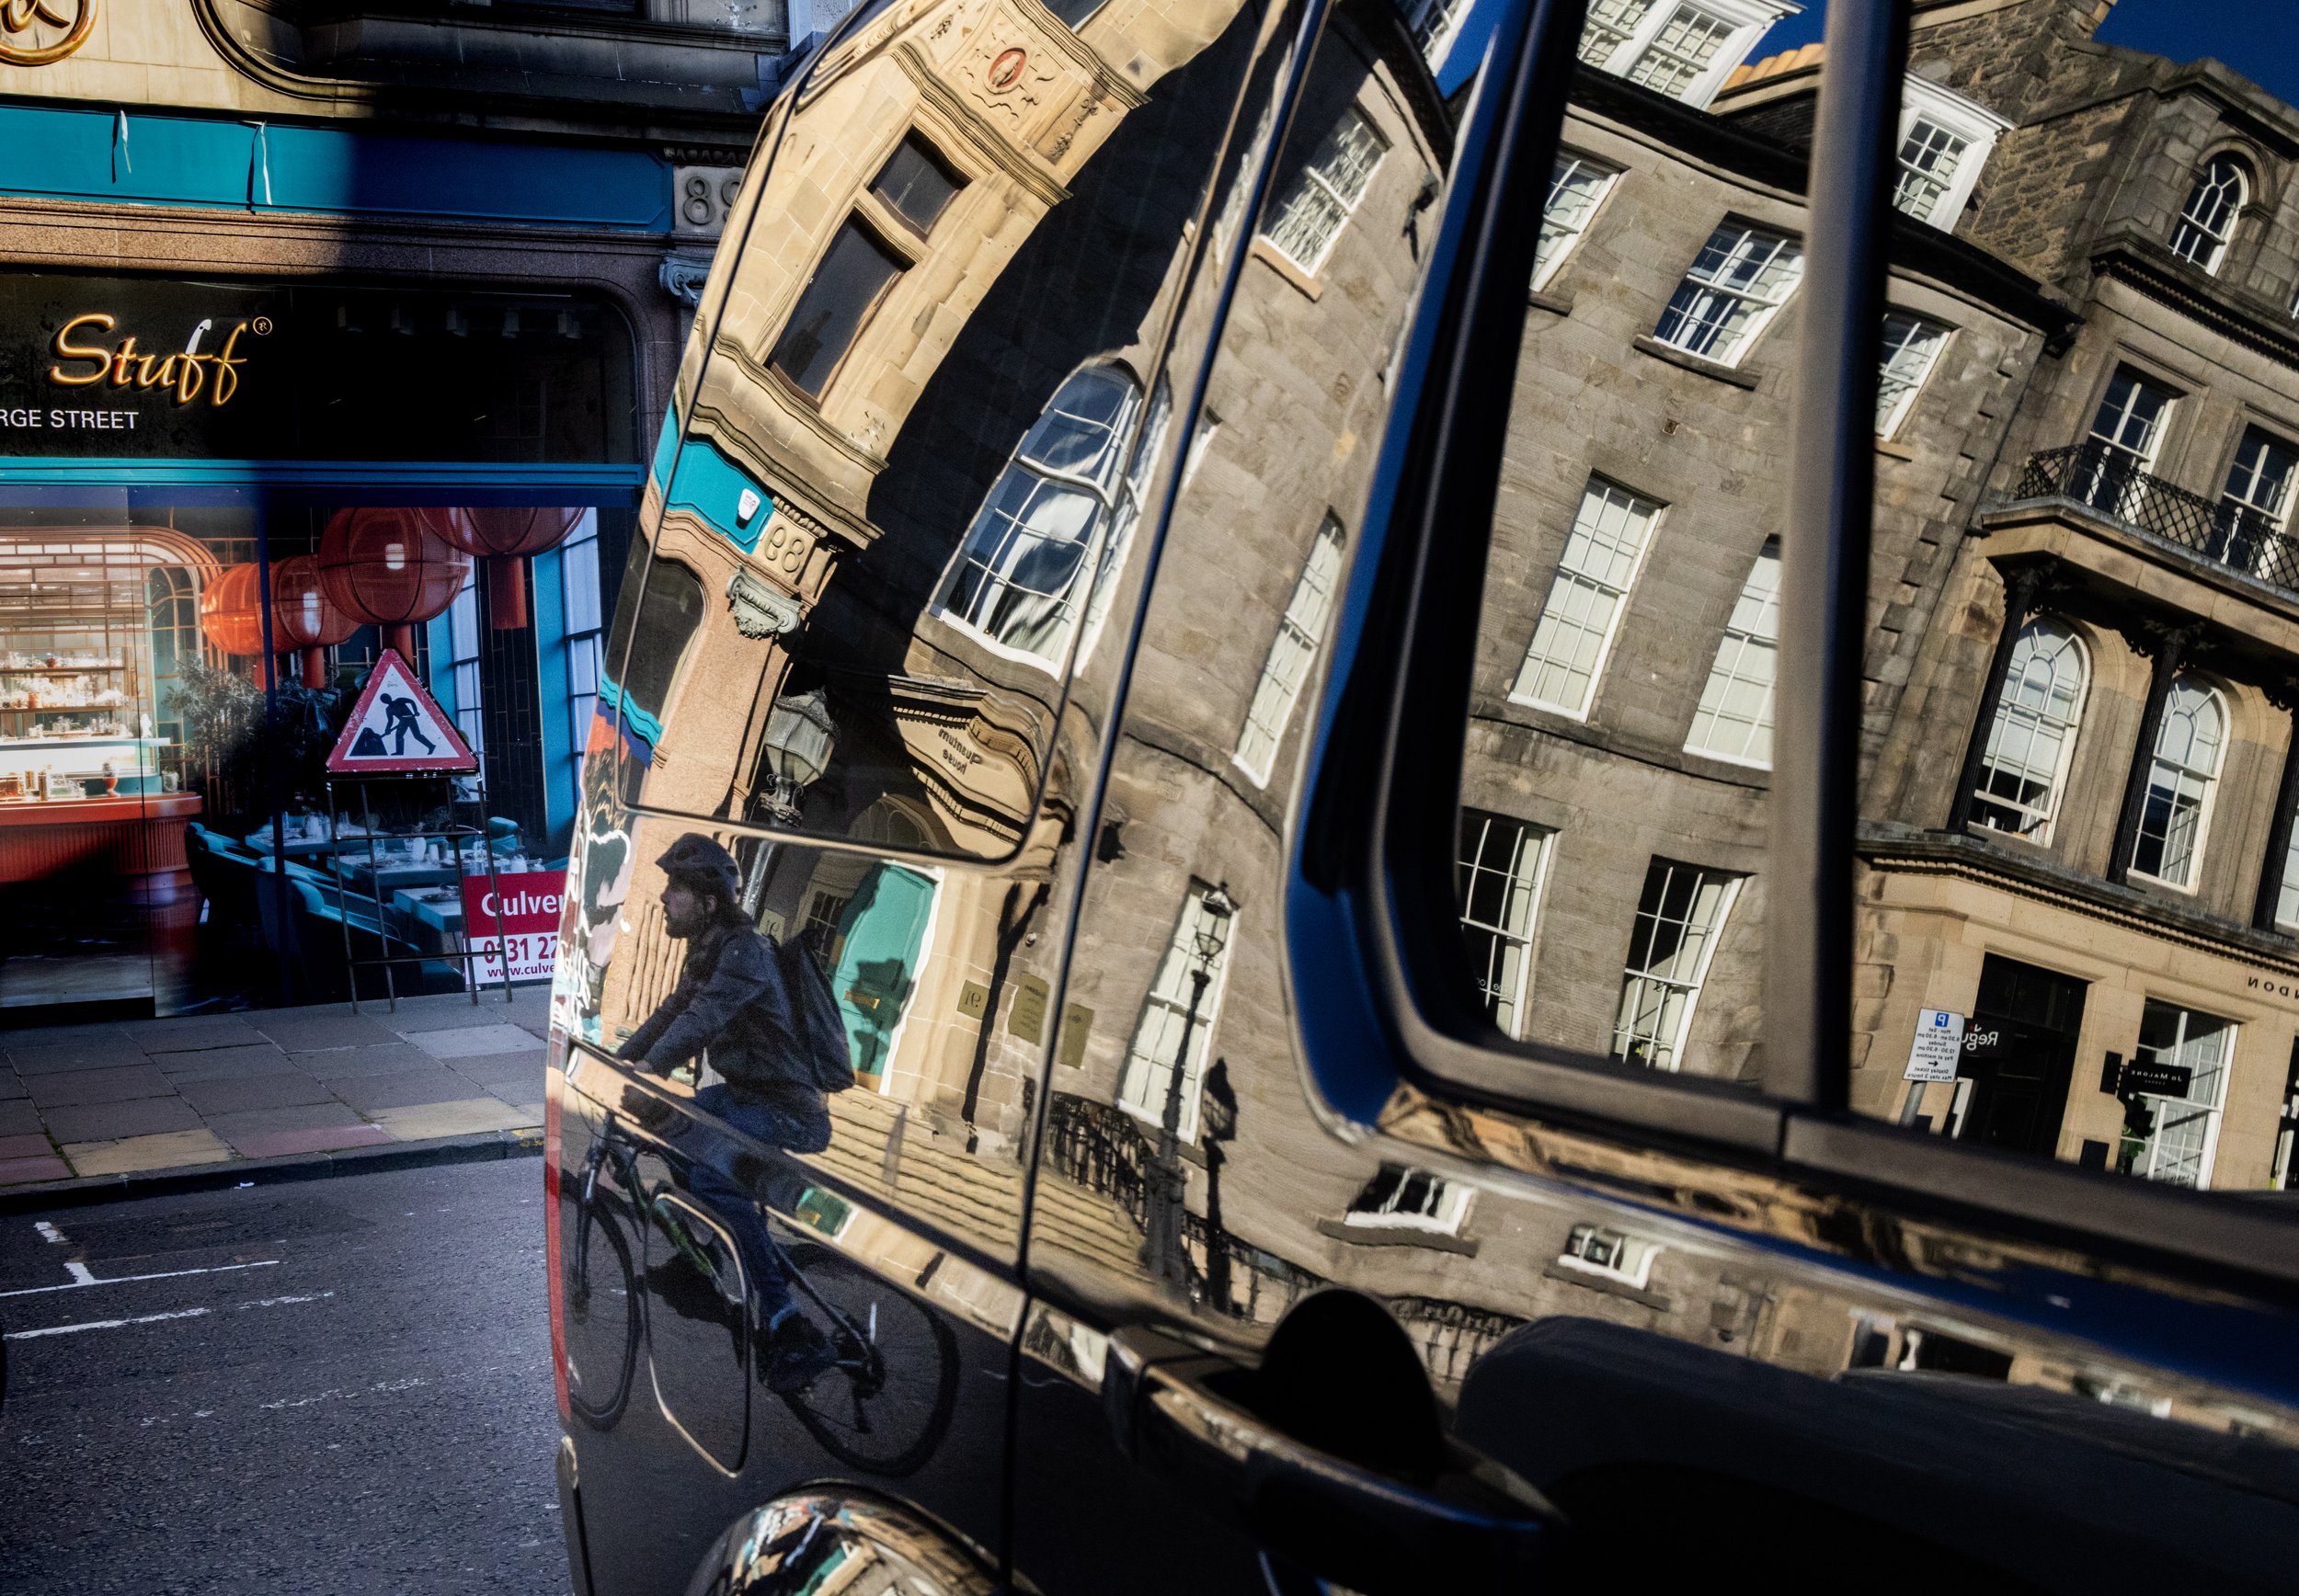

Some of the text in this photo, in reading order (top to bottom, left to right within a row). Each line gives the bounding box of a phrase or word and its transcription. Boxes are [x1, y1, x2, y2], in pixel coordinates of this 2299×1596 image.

[50, 314, 247, 407] Stuff
[50, 409, 140, 429] STREET
[484, 937, 529, 963] 031
